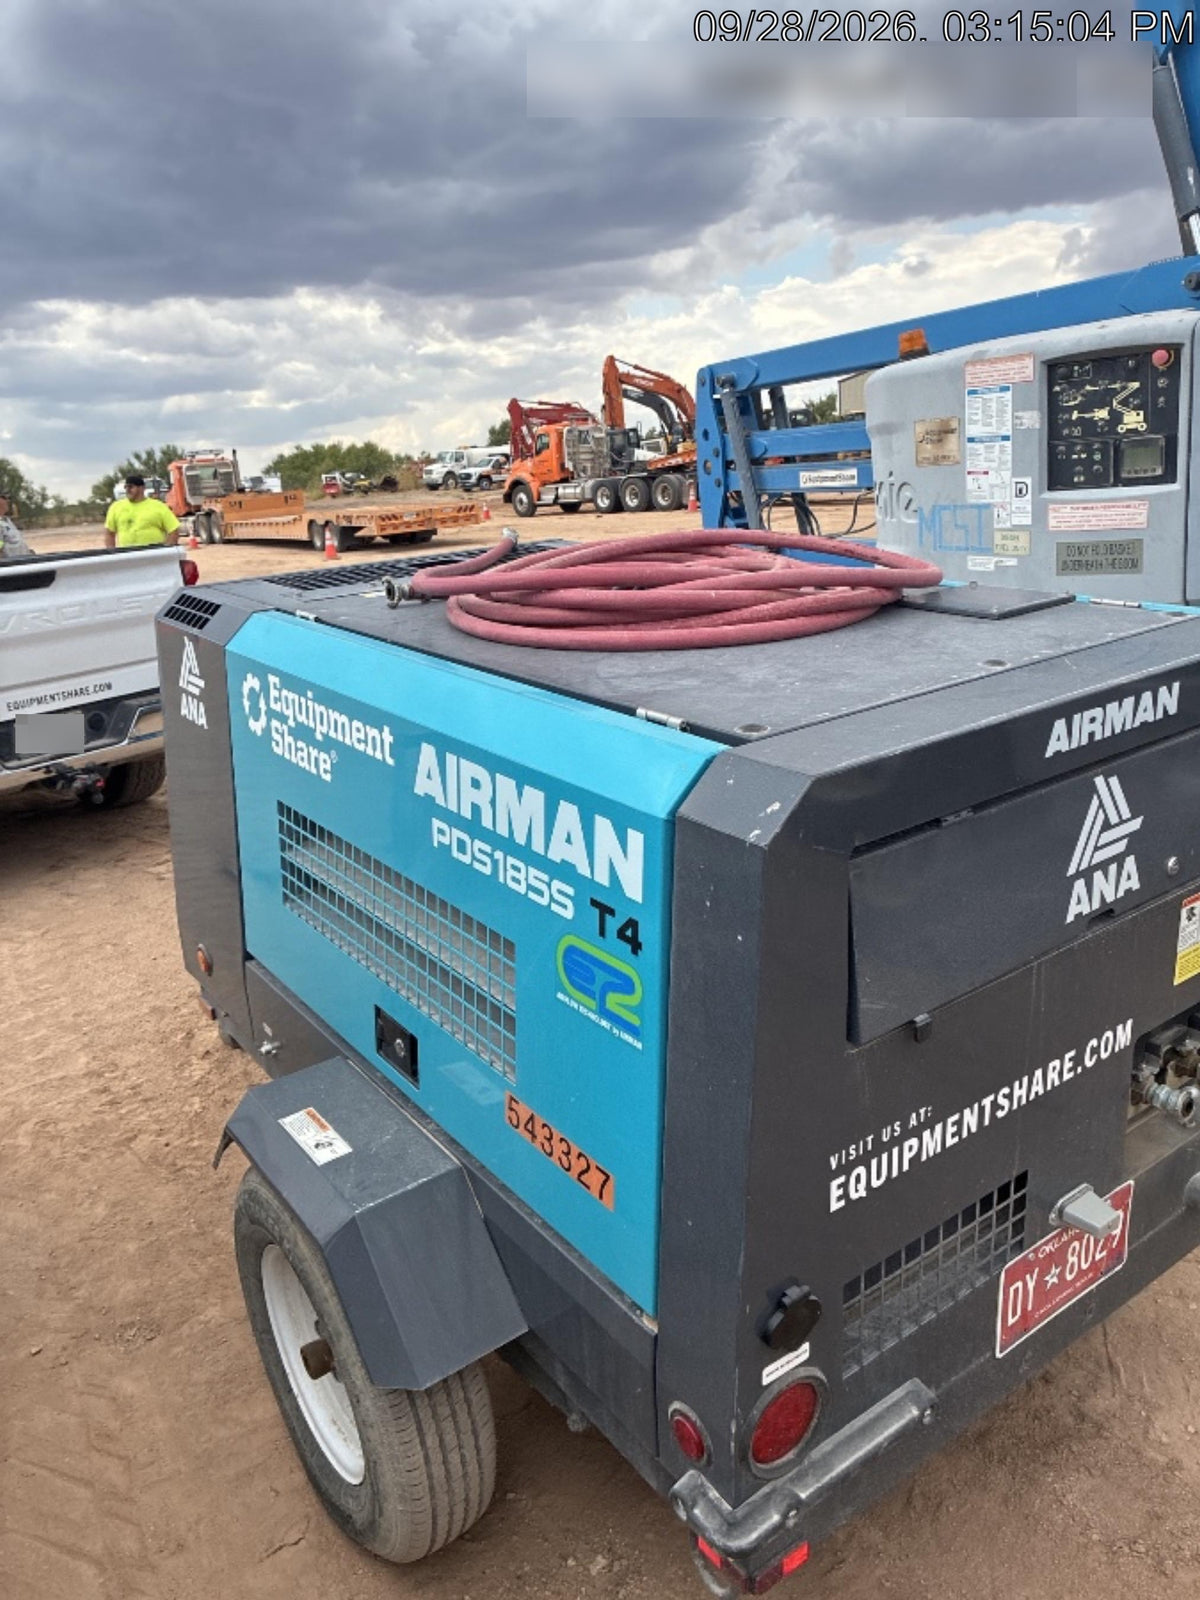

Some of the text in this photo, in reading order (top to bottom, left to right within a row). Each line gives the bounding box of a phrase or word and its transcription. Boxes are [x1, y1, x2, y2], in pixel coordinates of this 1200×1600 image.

[6, 682, 113, 713] EQUIPMENTSHARE.COM
[180, 692, 208, 730] ANA
[267, 673, 395, 767] Equipment
[1044, 681, 1180, 758] AIRMAN
[413, 742, 645, 904] AIRMAN
[431, 817, 643, 957] PDS185S T4
[1065, 854, 1141, 924] ANA
[508, 1095, 611, 1201] 543327
[829, 1019, 1134, 1213] EQUIPMENTSHARE.COM
[829, 1106, 933, 1171] VISIT US AT:
[1007, 1267, 1040, 1328] DY
